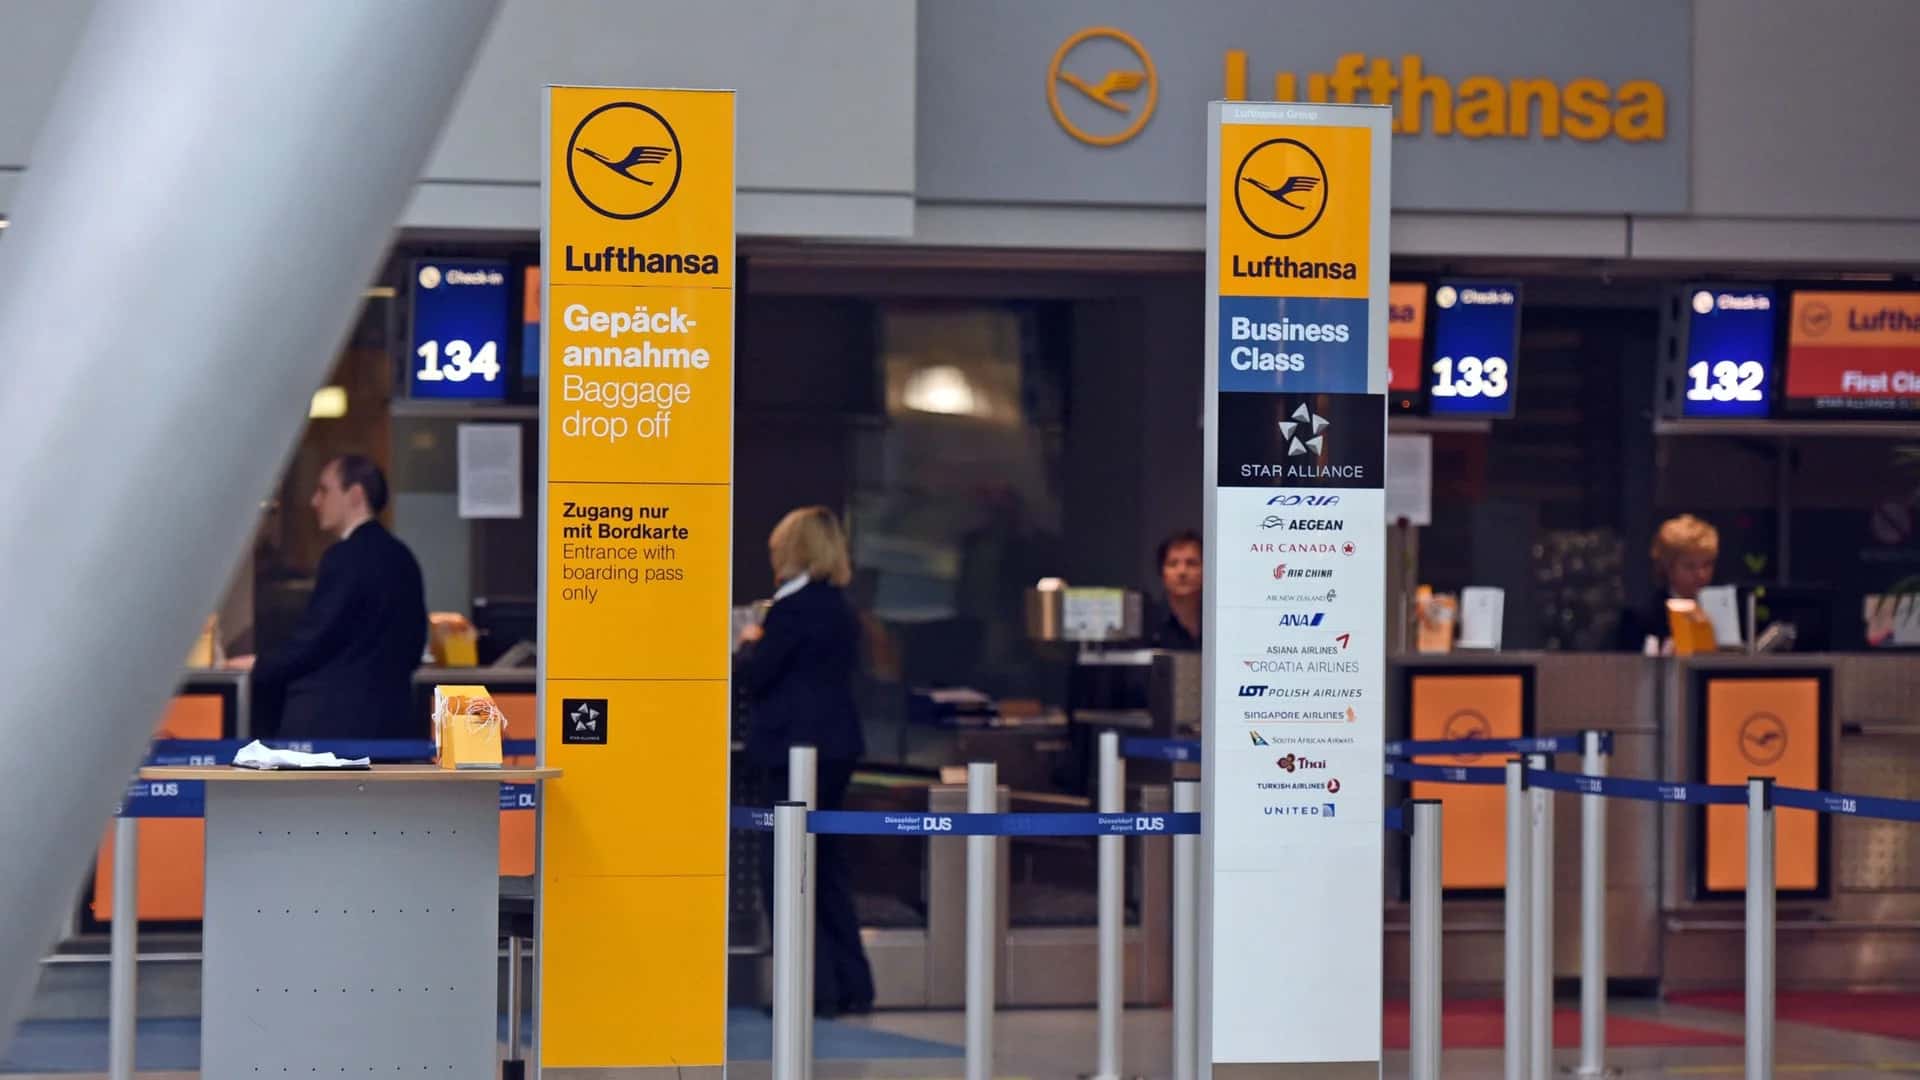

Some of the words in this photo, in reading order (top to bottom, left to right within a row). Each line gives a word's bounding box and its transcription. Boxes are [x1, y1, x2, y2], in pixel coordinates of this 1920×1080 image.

[565, 245, 719, 274] Lufthansa
[1232, 255, 1357, 280] Lufthansa
[563, 304, 697, 338] Gepäck-
[1231, 316, 1350, 342] Business
[417, 339, 500, 382] 134
[562, 340, 710, 369] annahme
[1230, 347, 1305, 371] Class
[1431, 356, 1508, 398] 133
[1686, 360, 1764, 401] 132
[563, 374, 691, 409] Baggage
[562, 409, 628, 443] drop
[637, 411, 671, 438] off
[1241, 464, 1282, 477] STAR
[1287, 465, 1364, 478] ALLIANCE
[1266, 495, 1341, 506] ADRIA
[563, 502, 633, 521] Zugang
[639, 505, 669, 519] nur
[563, 524, 592, 538] mit
[599, 524, 689, 540] Bordkarte
[1288, 519, 1343, 531] AEGEAN
[563, 543, 638, 560] Entrance
[643, 544, 675, 560] with
[1250, 543, 1275, 553] AIR
[1278, 543, 1337, 553] CANADA
[563, 564, 638, 583] boarding
[645, 567, 684, 584] pass
[1288, 569, 1303, 578] AIR
[1305, 569, 1333, 578] CHINA
[562, 585, 598, 604] only
[1278, 614, 1310, 627] ANA
[1266, 646, 1298, 655] ASIANA
[1301, 646, 1338, 655] AIRLINES
[1250, 661, 1303, 673] CROATIA
[1307, 661, 1359, 673] AIRLINES
[1238, 685, 1268, 697] LOT
[1268, 688, 1310, 697] POLISH
[1313, 689, 1363, 698] AIRLINES
[1243, 711, 1300, 720] SINGAPORE
[1302, 711, 1345, 720] AIRLINES
[151, 783, 179, 797] DUS
[519, 793, 536, 807] DU
[1264, 807, 1319, 816] UNITED
[923, 817, 952, 831] DUS
[1136, 817, 1165, 831] DUS
